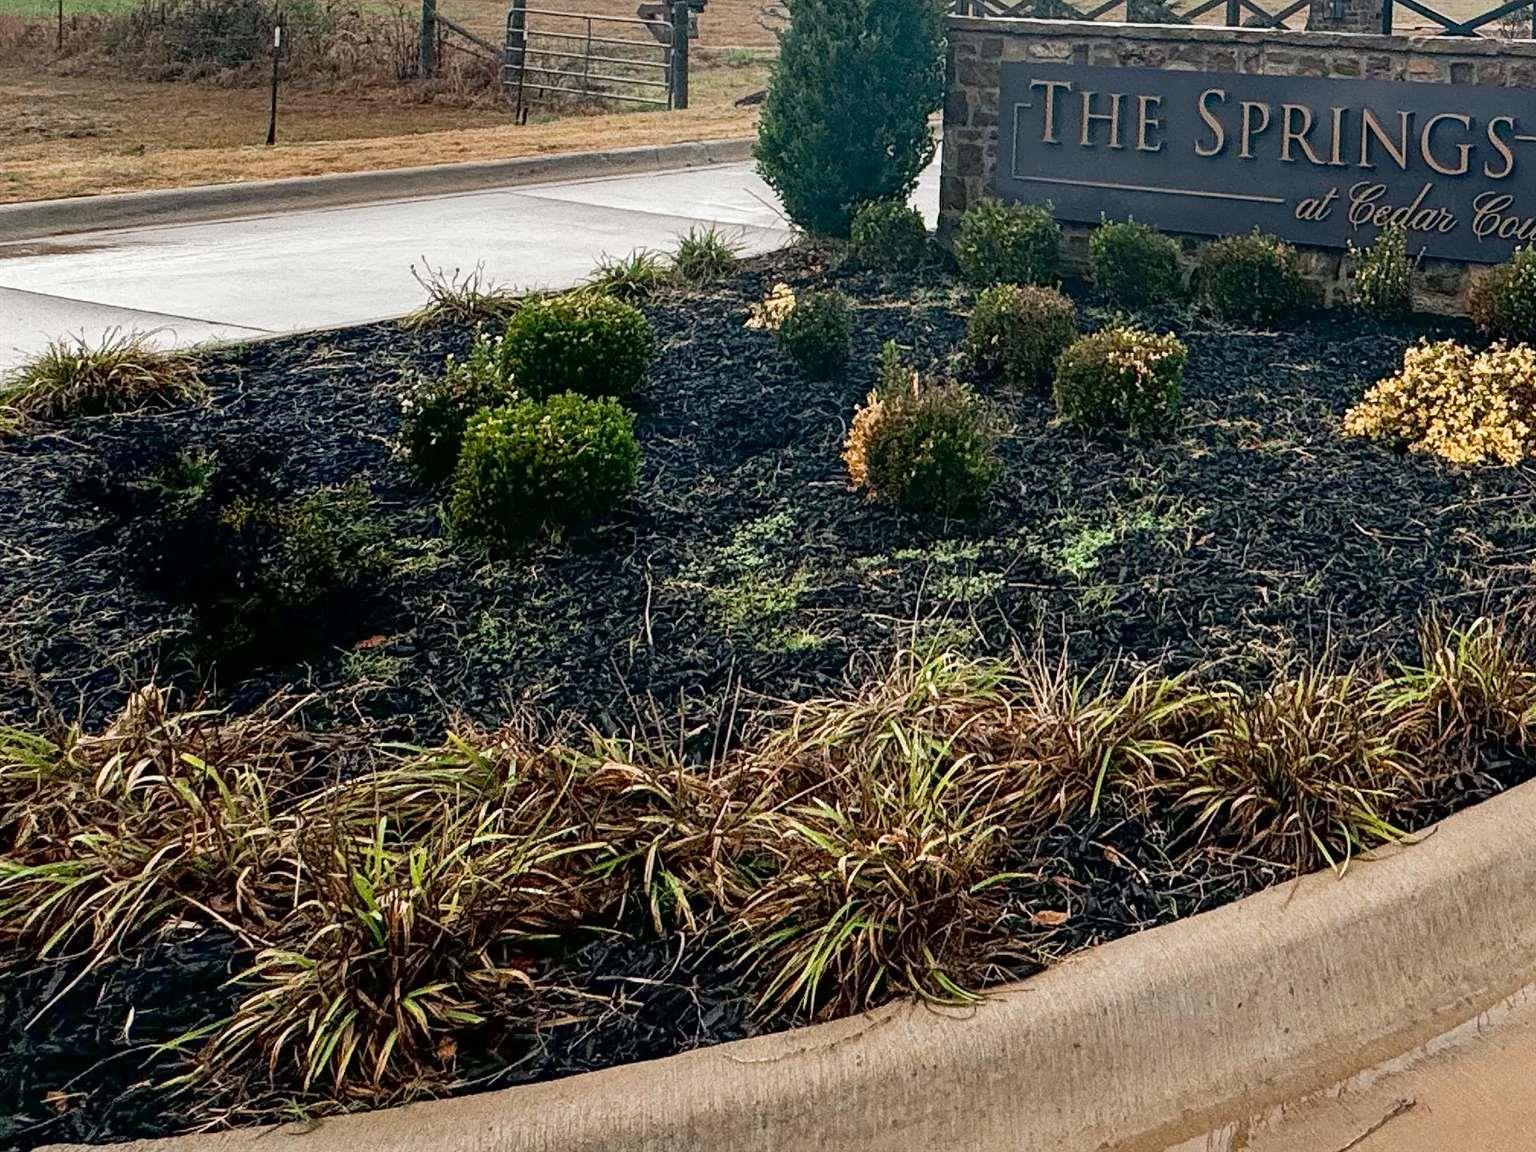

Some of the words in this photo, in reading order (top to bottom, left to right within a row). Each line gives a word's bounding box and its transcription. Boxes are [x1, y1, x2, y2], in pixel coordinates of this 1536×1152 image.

[1029, 79, 1164, 152] THE
[1195, 88, 1516, 178] SPRINGS
[1296, 187, 1338, 221] at
[1348, 181, 1460, 233] Cedar
